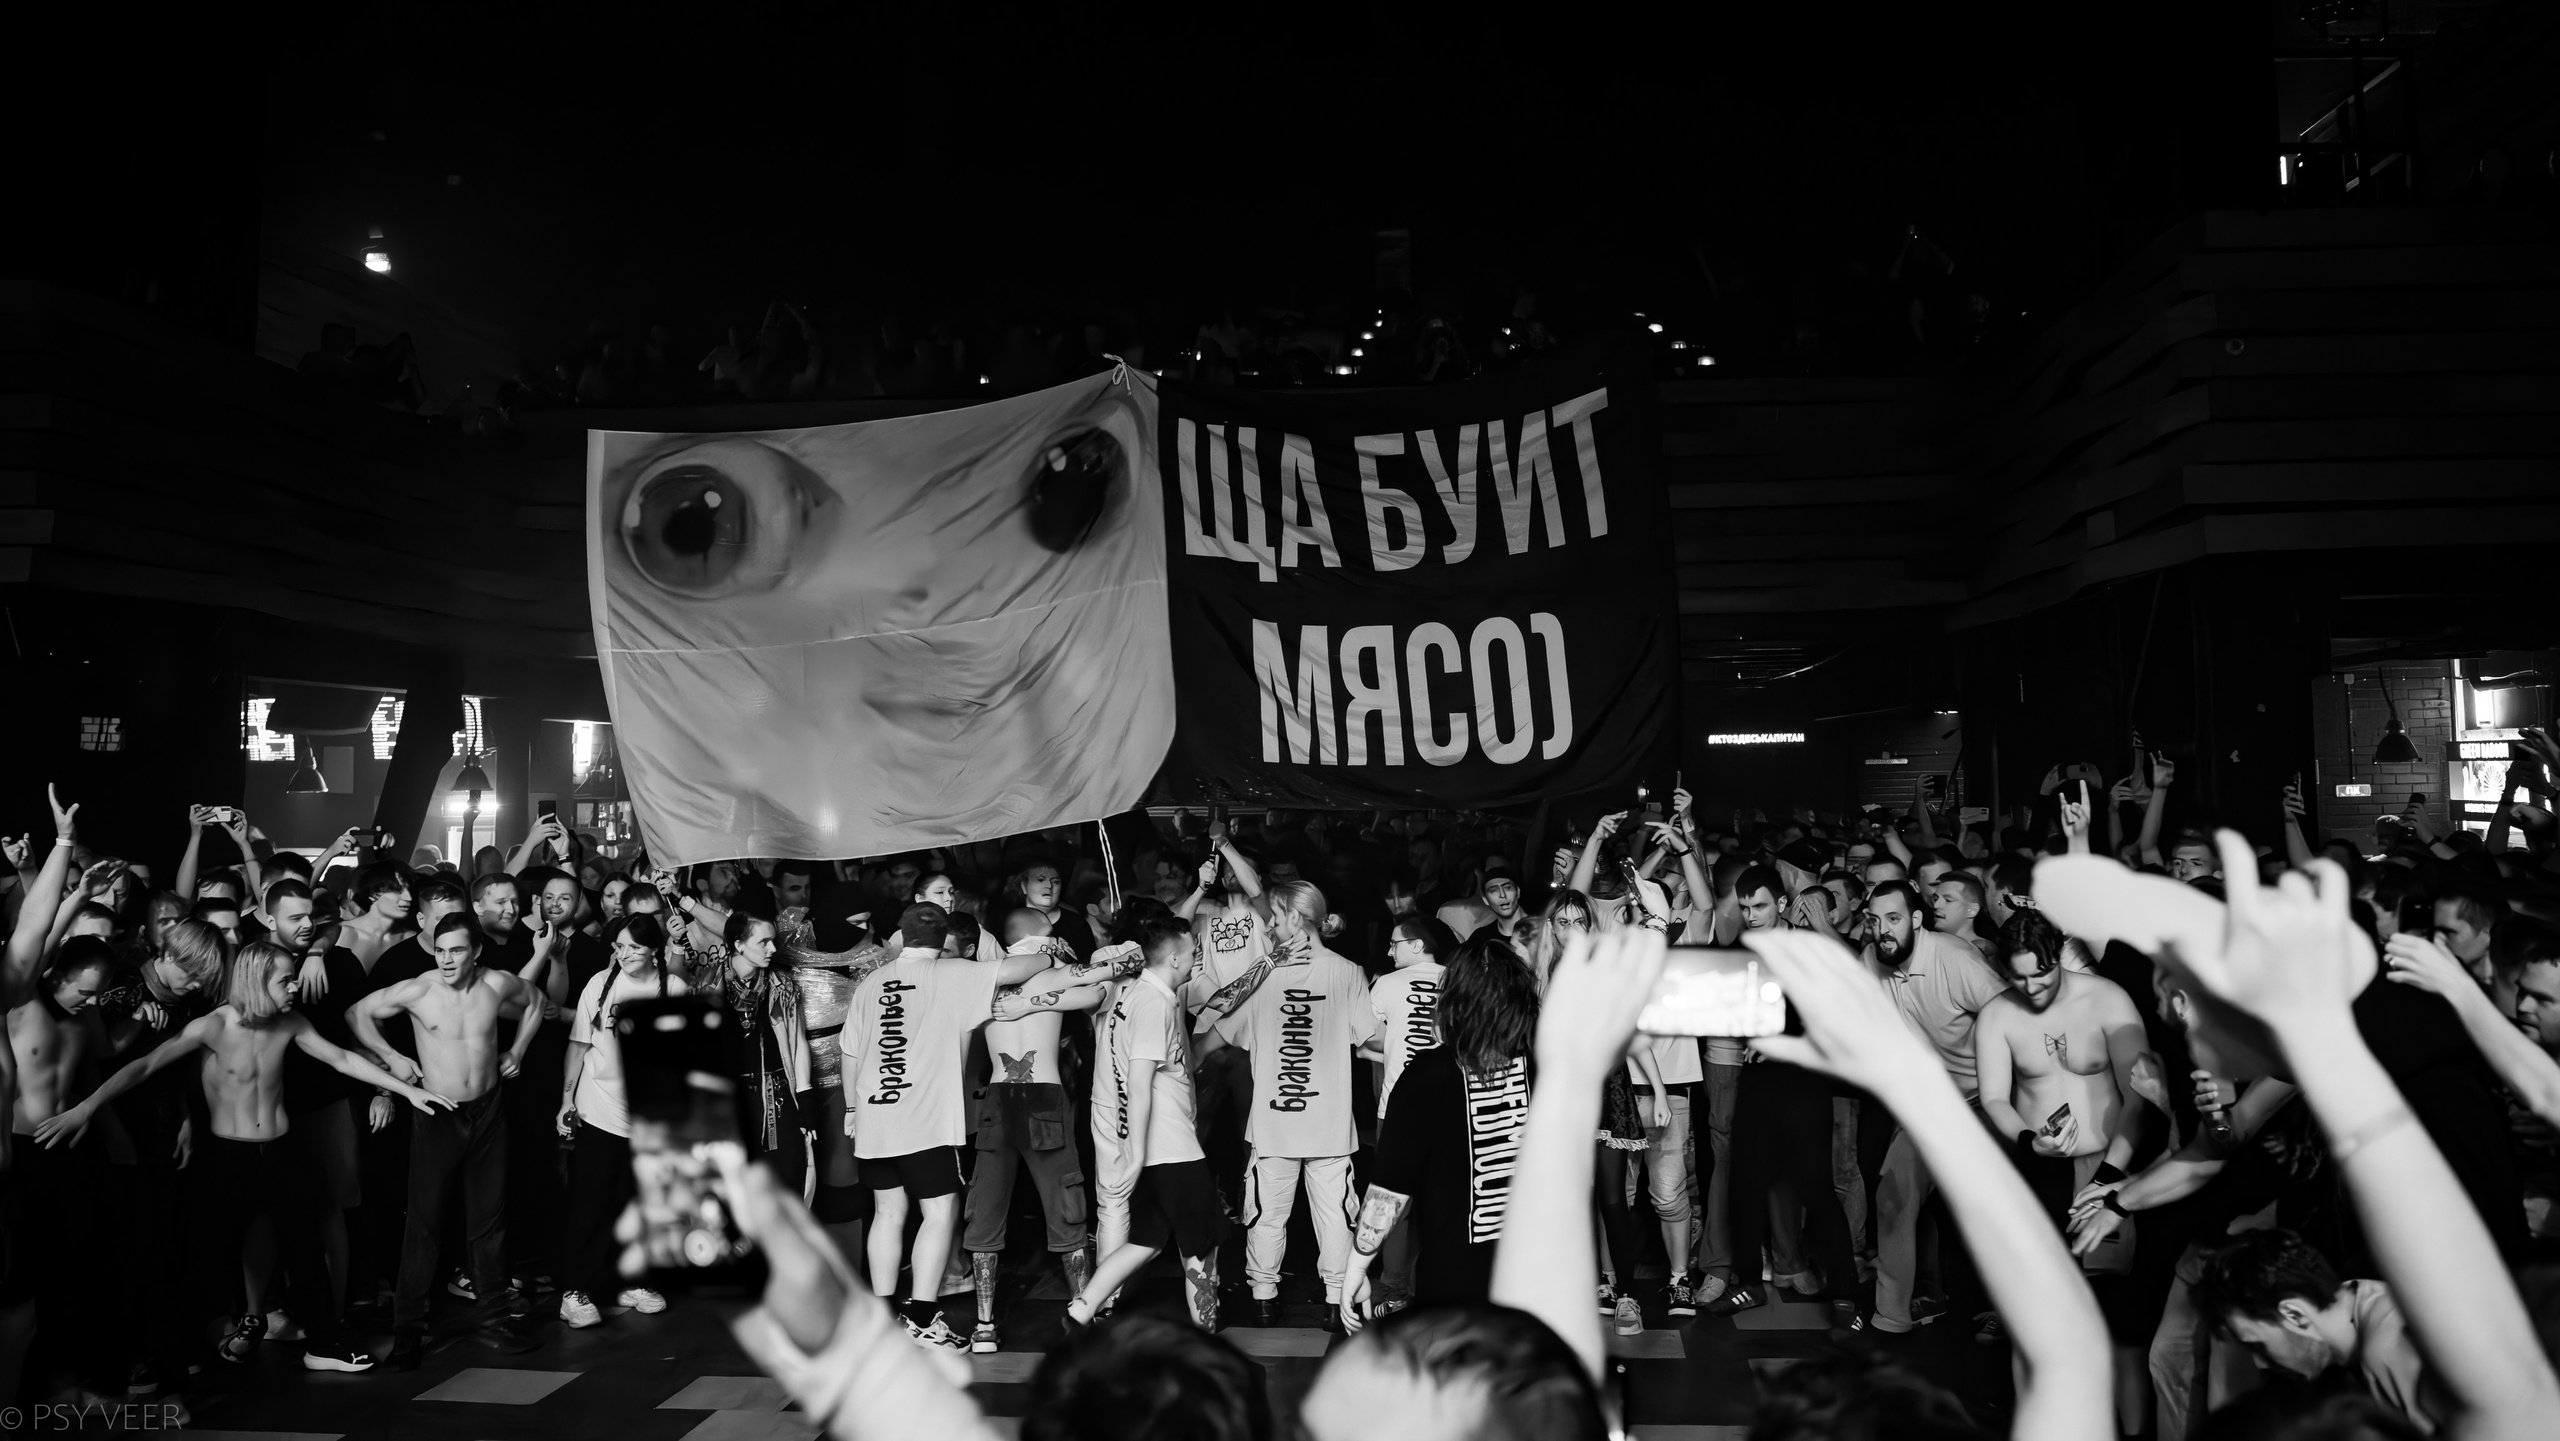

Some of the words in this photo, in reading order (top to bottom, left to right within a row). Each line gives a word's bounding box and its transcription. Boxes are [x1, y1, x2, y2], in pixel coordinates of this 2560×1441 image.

[1176, 417, 1341, 583] ЩА
[1354, 386, 1609, 572] БУИТ
[1252, 611, 1573, 767] МЯСО)
[1708, 733, 1805, 745] #КТОЗДЕСЬКАПИТАН
[868, 979, 916, 1105] браконьер
[1269, 989, 1327, 1112] браконьер
